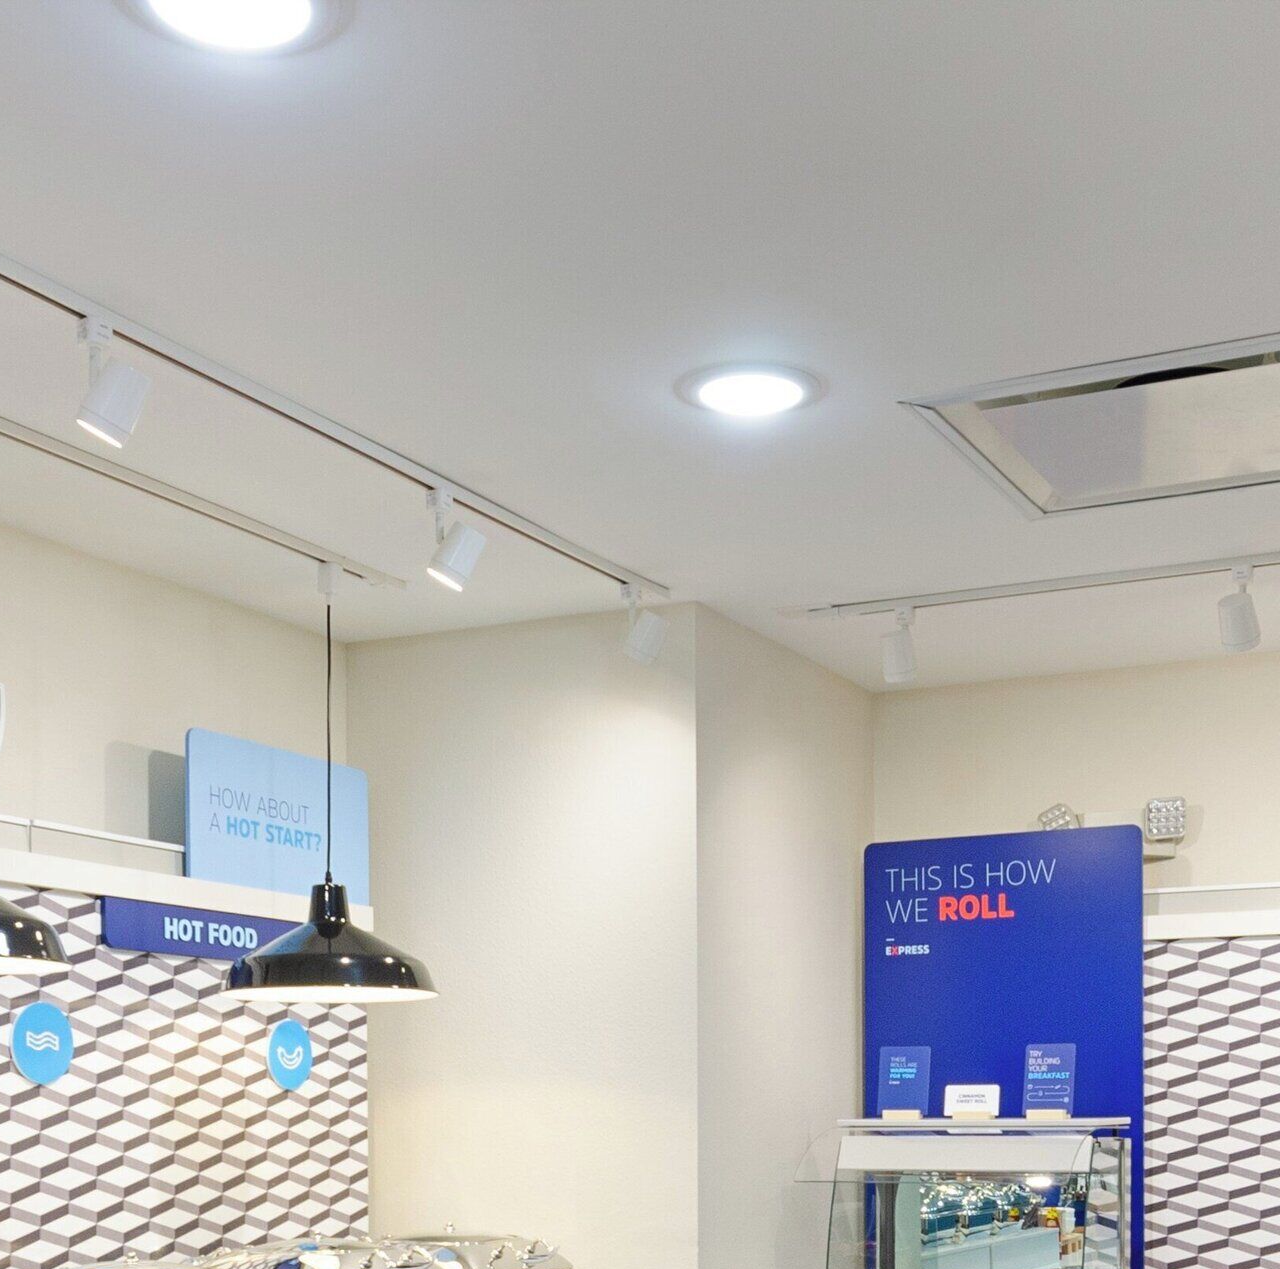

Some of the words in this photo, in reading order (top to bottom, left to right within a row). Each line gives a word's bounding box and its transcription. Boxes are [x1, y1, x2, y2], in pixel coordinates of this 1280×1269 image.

[209, 784, 252, 813] HOW
[257, 796, 310, 825] ABOUT
[209, 812, 221, 833] A
[226, 815, 260, 840] HOT
[265, 822, 322, 852] START?
[885, 866, 943, 893] THIS
[953, 863, 975, 889] IS
[986, 858, 1057, 887] HOW
[885, 898, 928, 924] WE
[938, 893, 1015, 921] ROLL
[164, 916, 204, 943] HOT
[208, 922, 258, 949] FOOD
[885, 945, 930, 956] EXPRESS
[1028, 1071, 1070, 1080] BREAKFAST
